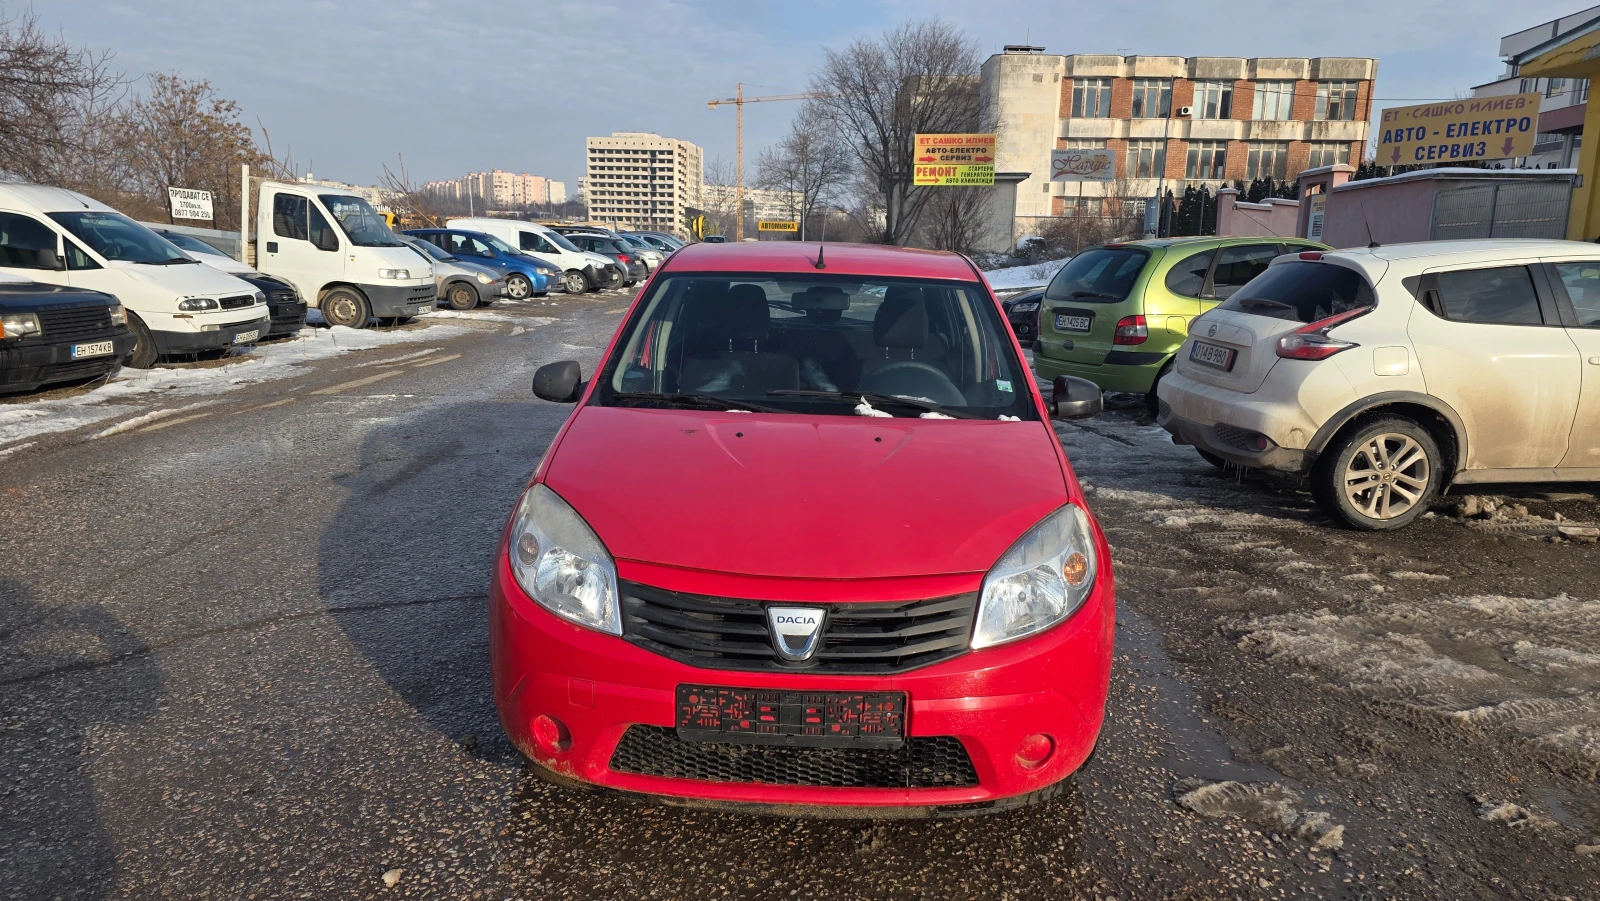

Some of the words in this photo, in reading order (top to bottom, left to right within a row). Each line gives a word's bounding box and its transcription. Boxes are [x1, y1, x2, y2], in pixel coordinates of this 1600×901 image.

[1383, 111, 1401, 122] ЕТ
[1412, 104, 1465, 119] САШКО
[1469, 97, 1526, 113] ИЛИЕВ
[1382, 126, 1427, 144] АВТО
[1445, 116, 1531, 139] ЕЛЕКТРО
[1414, 141, 1487, 161] СЕРВИЗ
[916, 166, 957, 177] РЕМОНТ
[170, 189, 200, 200] ПРОДАВАТ
[201, 192, 210, 201] СЕ
[1059, 316, 1067, 326] EH
[1067, 317, 1079, 327] 1425
[1079, 317, 1089, 328] BC
[76, 346, 86, 356] EH
[87, 344, 103, 354] 1574
[103, 342, 112, 353] KB
[777, 616, 815, 624] DACIA
